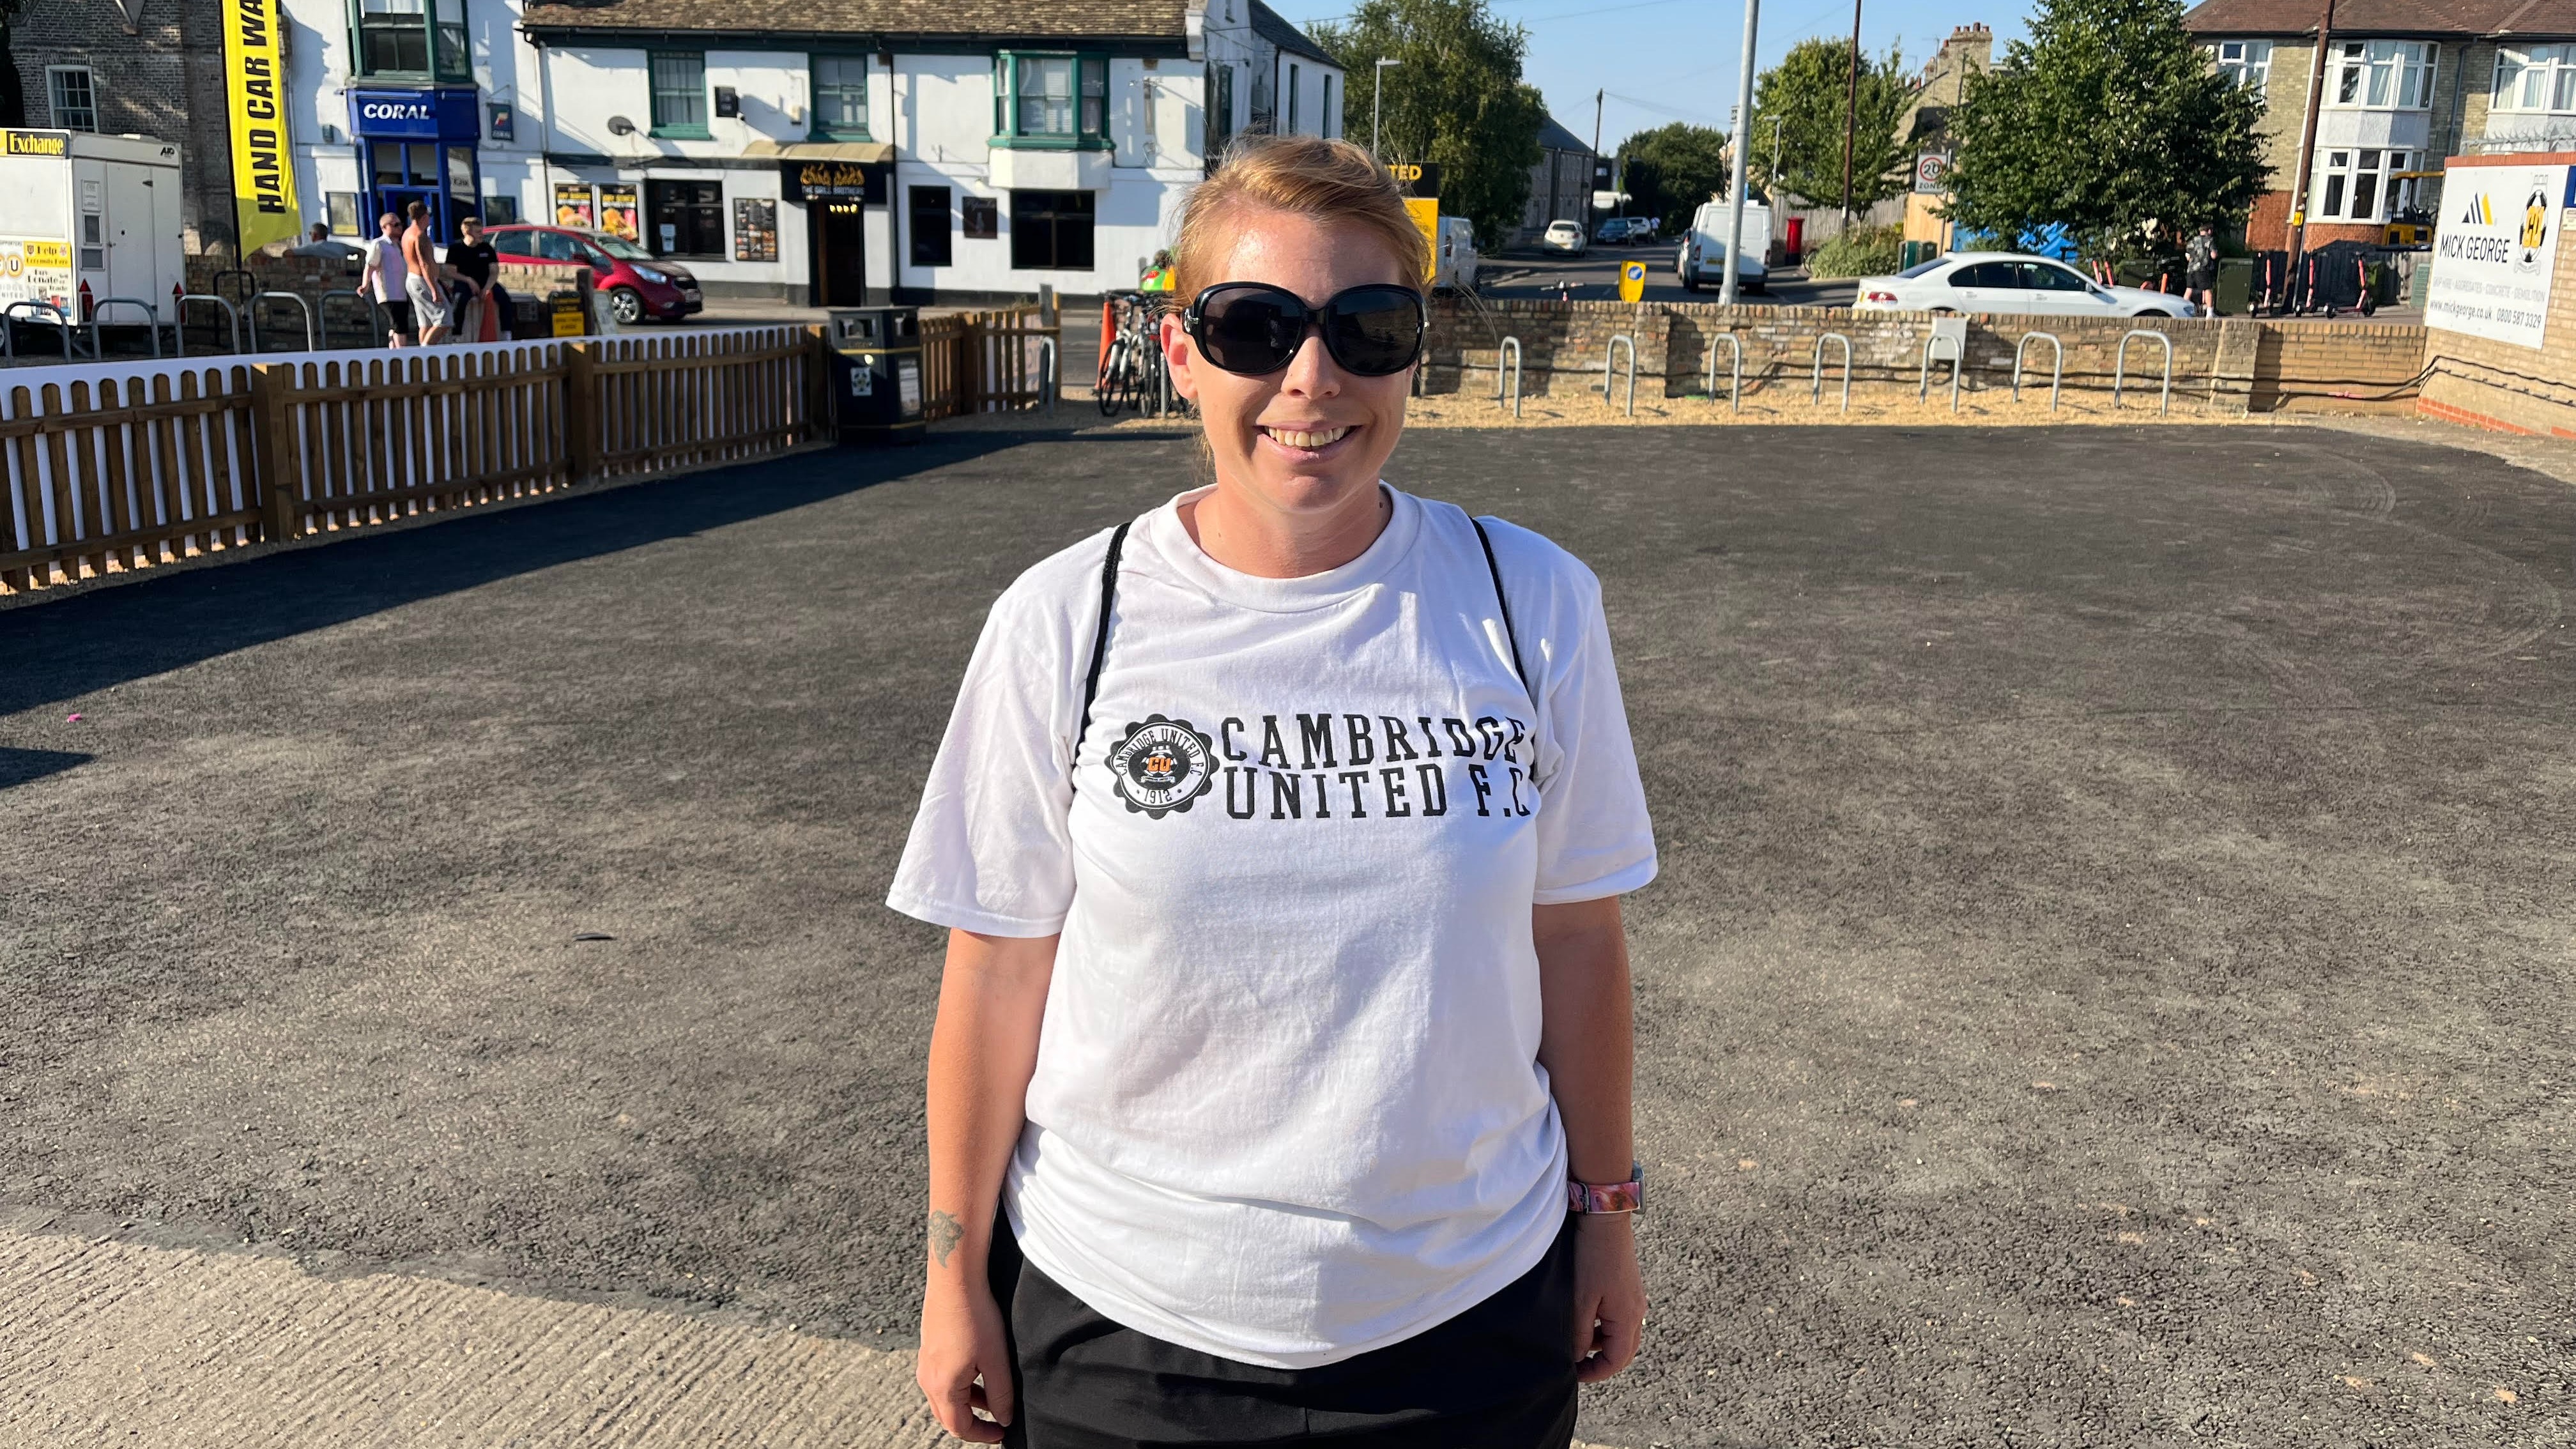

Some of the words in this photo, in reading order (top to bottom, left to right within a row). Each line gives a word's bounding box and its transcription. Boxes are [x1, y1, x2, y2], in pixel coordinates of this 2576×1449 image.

[245, 56, 275, 120] CAR
[363, 103, 431, 120] CORAL
[9, 132, 64, 155] Exchange
[249, 129, 286, 214] HAND
[1924, 164, 1940, 174] 20
[2439, 234, 2467, 259] MICK
[2467, 236, 2511, 263] GEORGE
[2430, 299, 2492, 320] www.mickgeorge.co.uk
[2496, 307, 2512, 324] 0800
[2512, 312, 2525, 326] 587
[2525, 314, 2542, 328] 3329
[1115, 730, 1156, 776] CAMBRIDGE
[1160, 728, 1201, 758] UNITED
[1221, 713, 1526, 770] CAMBRIDGE
[1147, 756, 1172, 772] CU
[1144, 790, 1172, 804] 1912
[1223, 763, 1447, 820] UNITED
